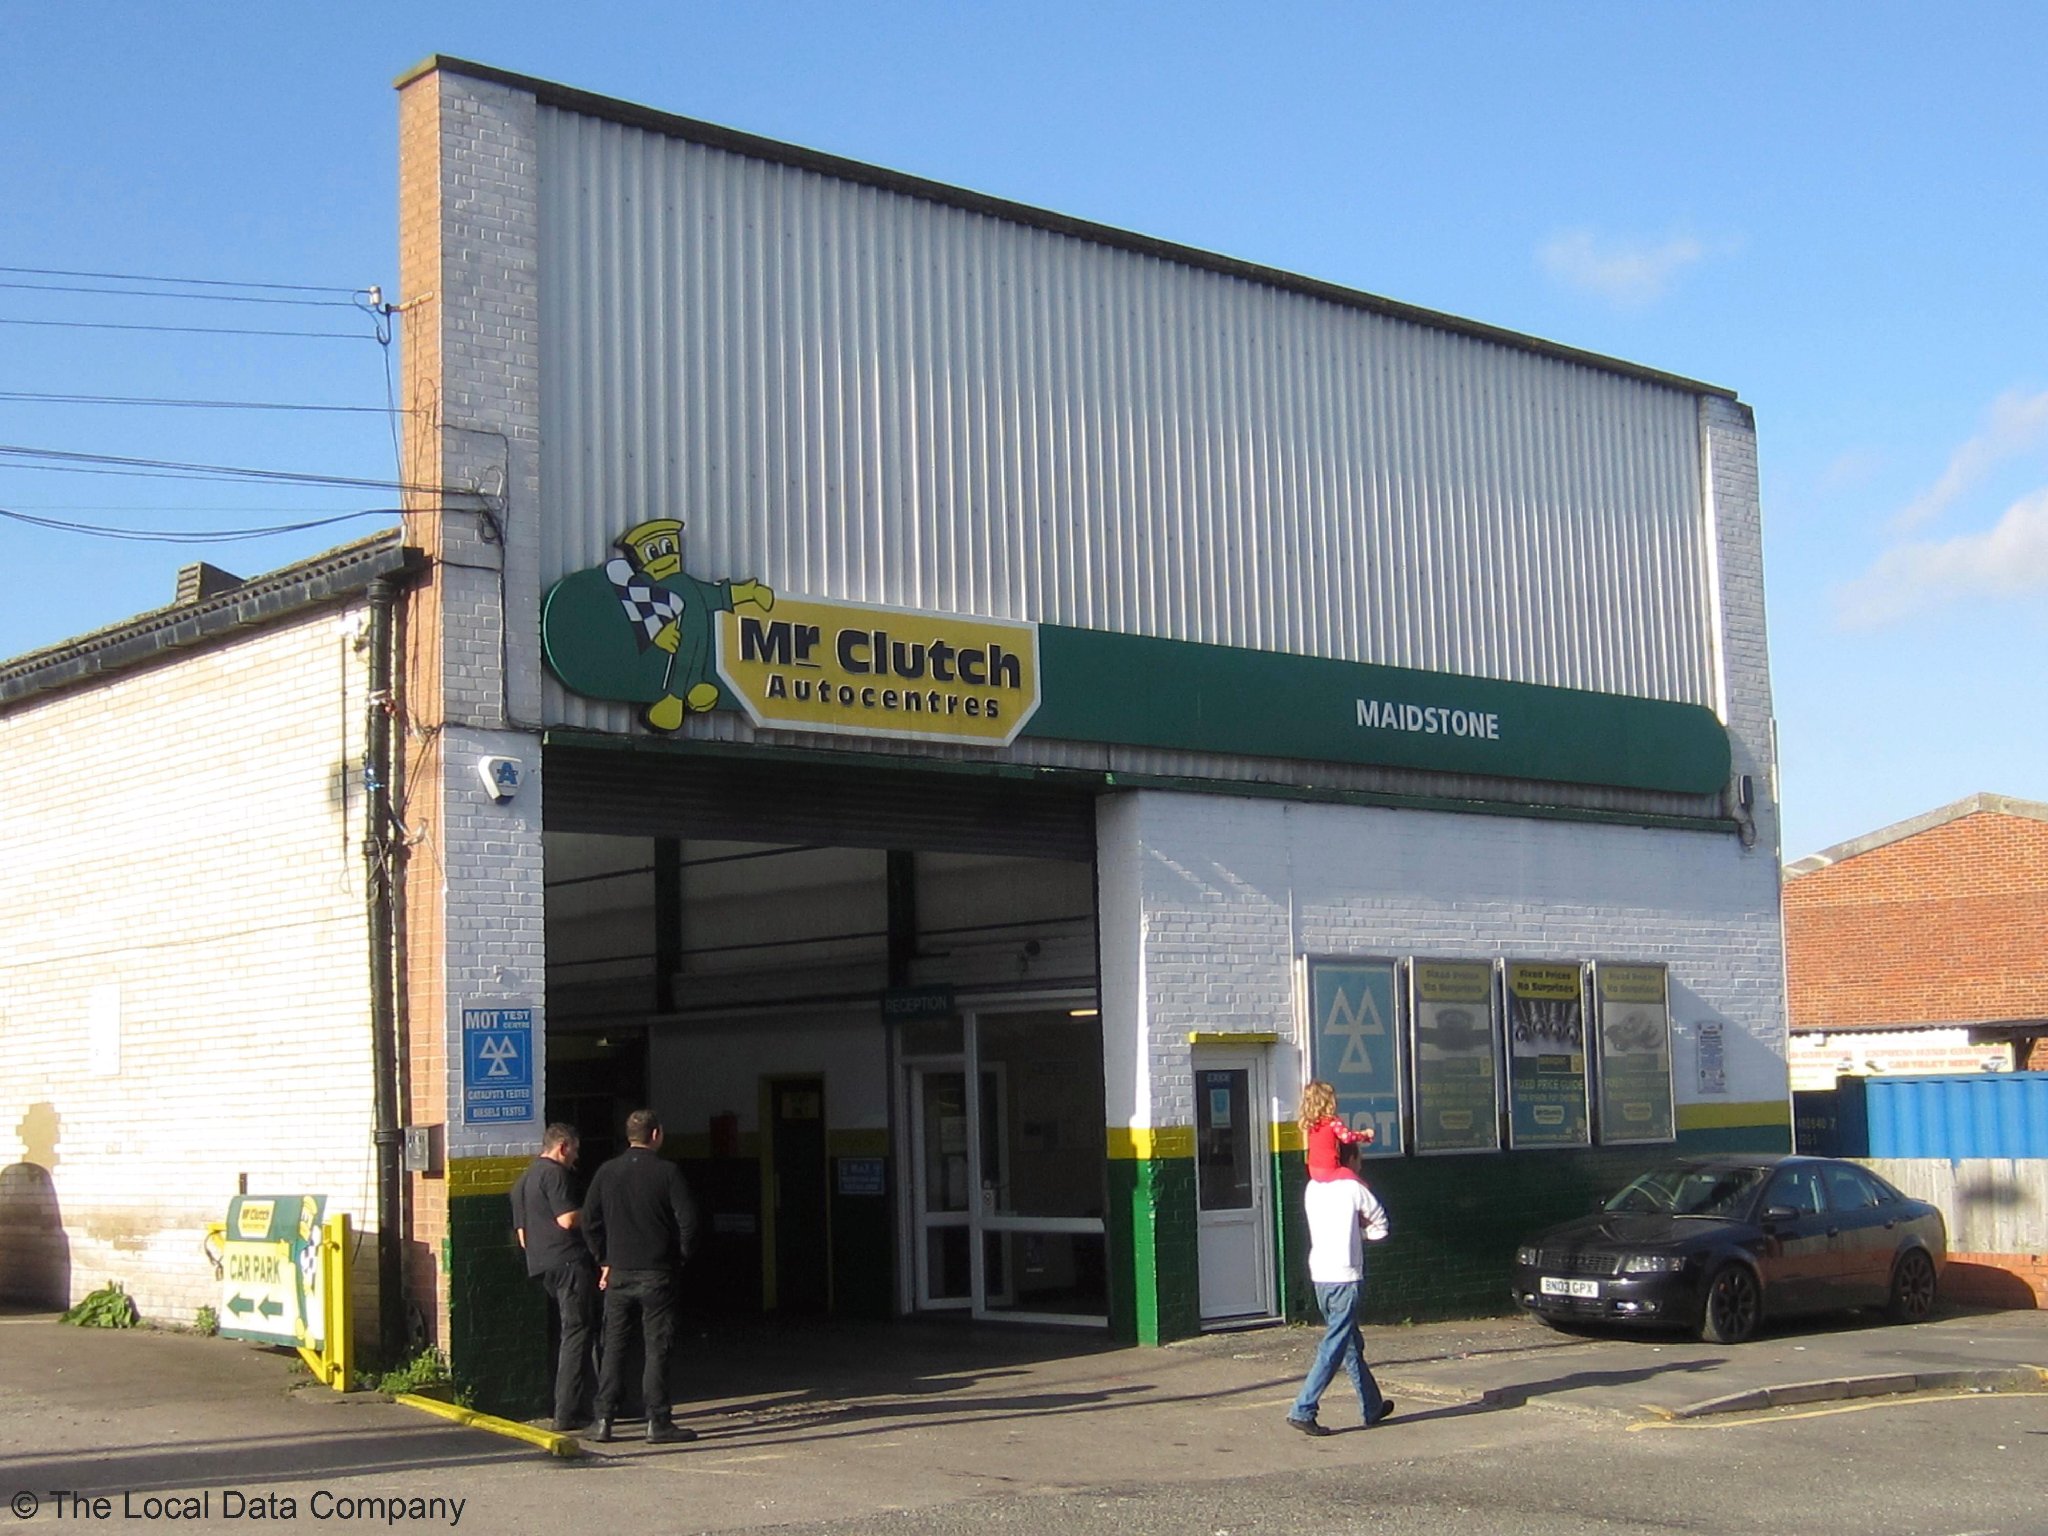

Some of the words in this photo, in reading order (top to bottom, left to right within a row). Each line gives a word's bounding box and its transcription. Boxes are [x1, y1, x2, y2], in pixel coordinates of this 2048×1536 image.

[738, 616, 821, 667] Mr
[835, 628, 1021, 690] Clutch
[765, 674, 1000, 719] Autocentres
[1356, 699, 1500, 740] MAIDSTONE
[1546, 971, 1571, 980] Prices
[1517, 982, 1529, 991] No
[1532, 983, 1574, 993] Surprises
[884, 996, 947, 1014] RECEPTION
[465, 1011, 500, 1029] MOT
[502, 1011, 530, 1020] TEST
[468, 1089, 504, 1100] CATALYSTS
[506, 1089, 530, 1099] TESTED
[502, 1106, 526, 1117] TESTED
[1336, 1111, 1396, 1147] OT
[230, 1254, 251, 1281] CAR
[253, 1255, 281, 1284] PARK
[1572, 1282, 1593, 1295] GPX
